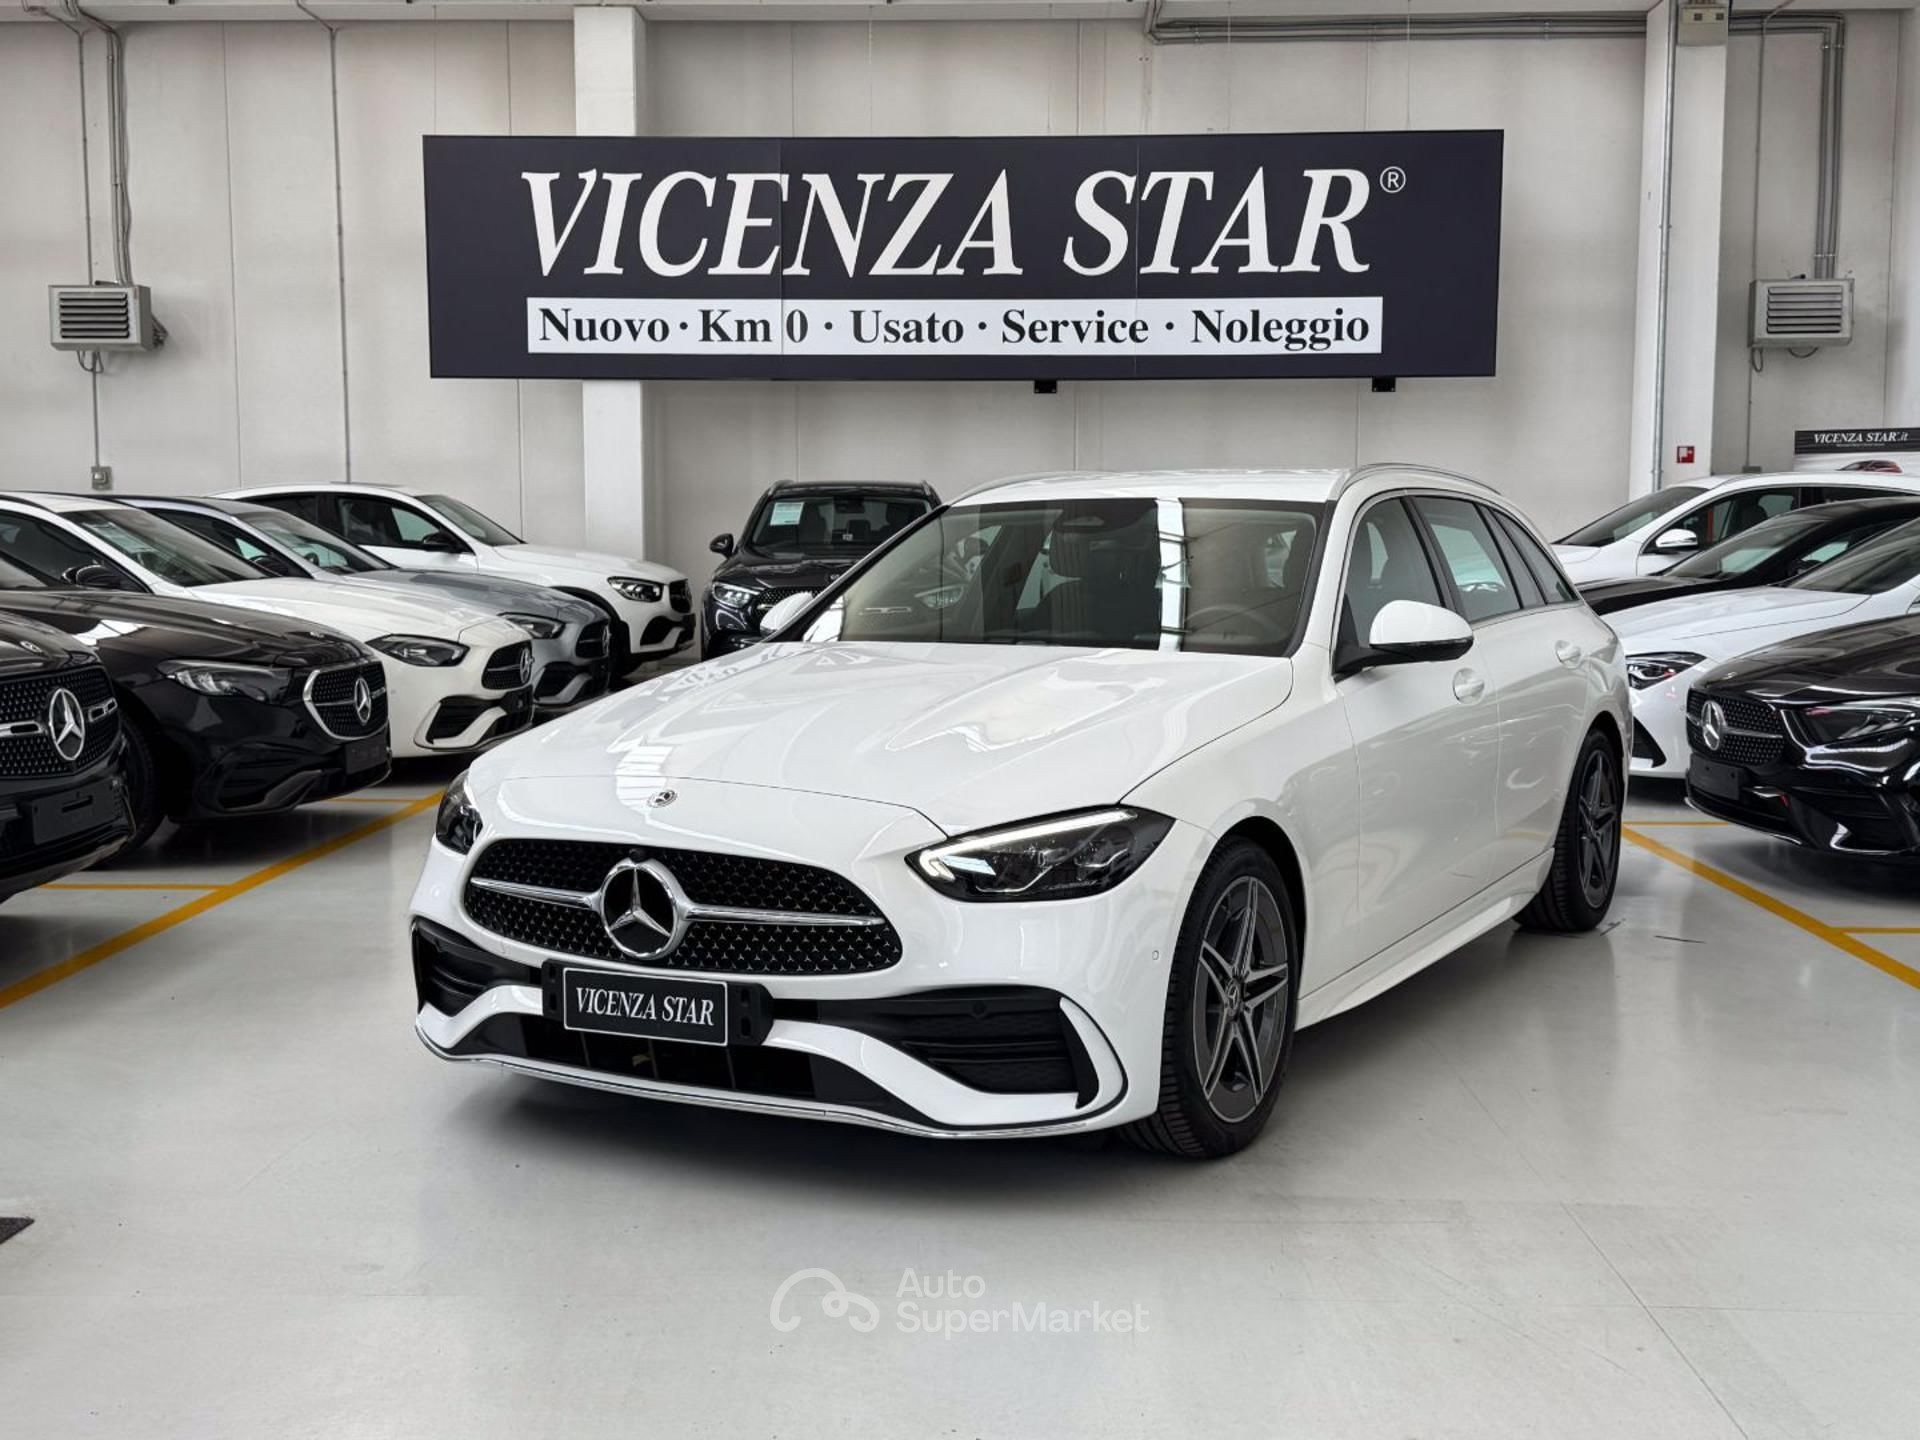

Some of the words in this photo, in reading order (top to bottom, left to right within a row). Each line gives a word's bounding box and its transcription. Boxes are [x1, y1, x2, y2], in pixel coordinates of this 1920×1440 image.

[521, 168, 1023, 278] VICENZA
[538, 308, 670, 343] Nuovo
[698, 309, 772, 343] Km
[786, 308, 809, 343] 0
[850, 310, 965, 344] Usato
[1001, 309, 1149, 344] Service
[1190, 307, 1369, 352] Noleggio
[1813, 432, 1864, 443] VICENZA
[576, 987, 657, 1020] VICENZA
[662, 995, 715, 1027] STAR
